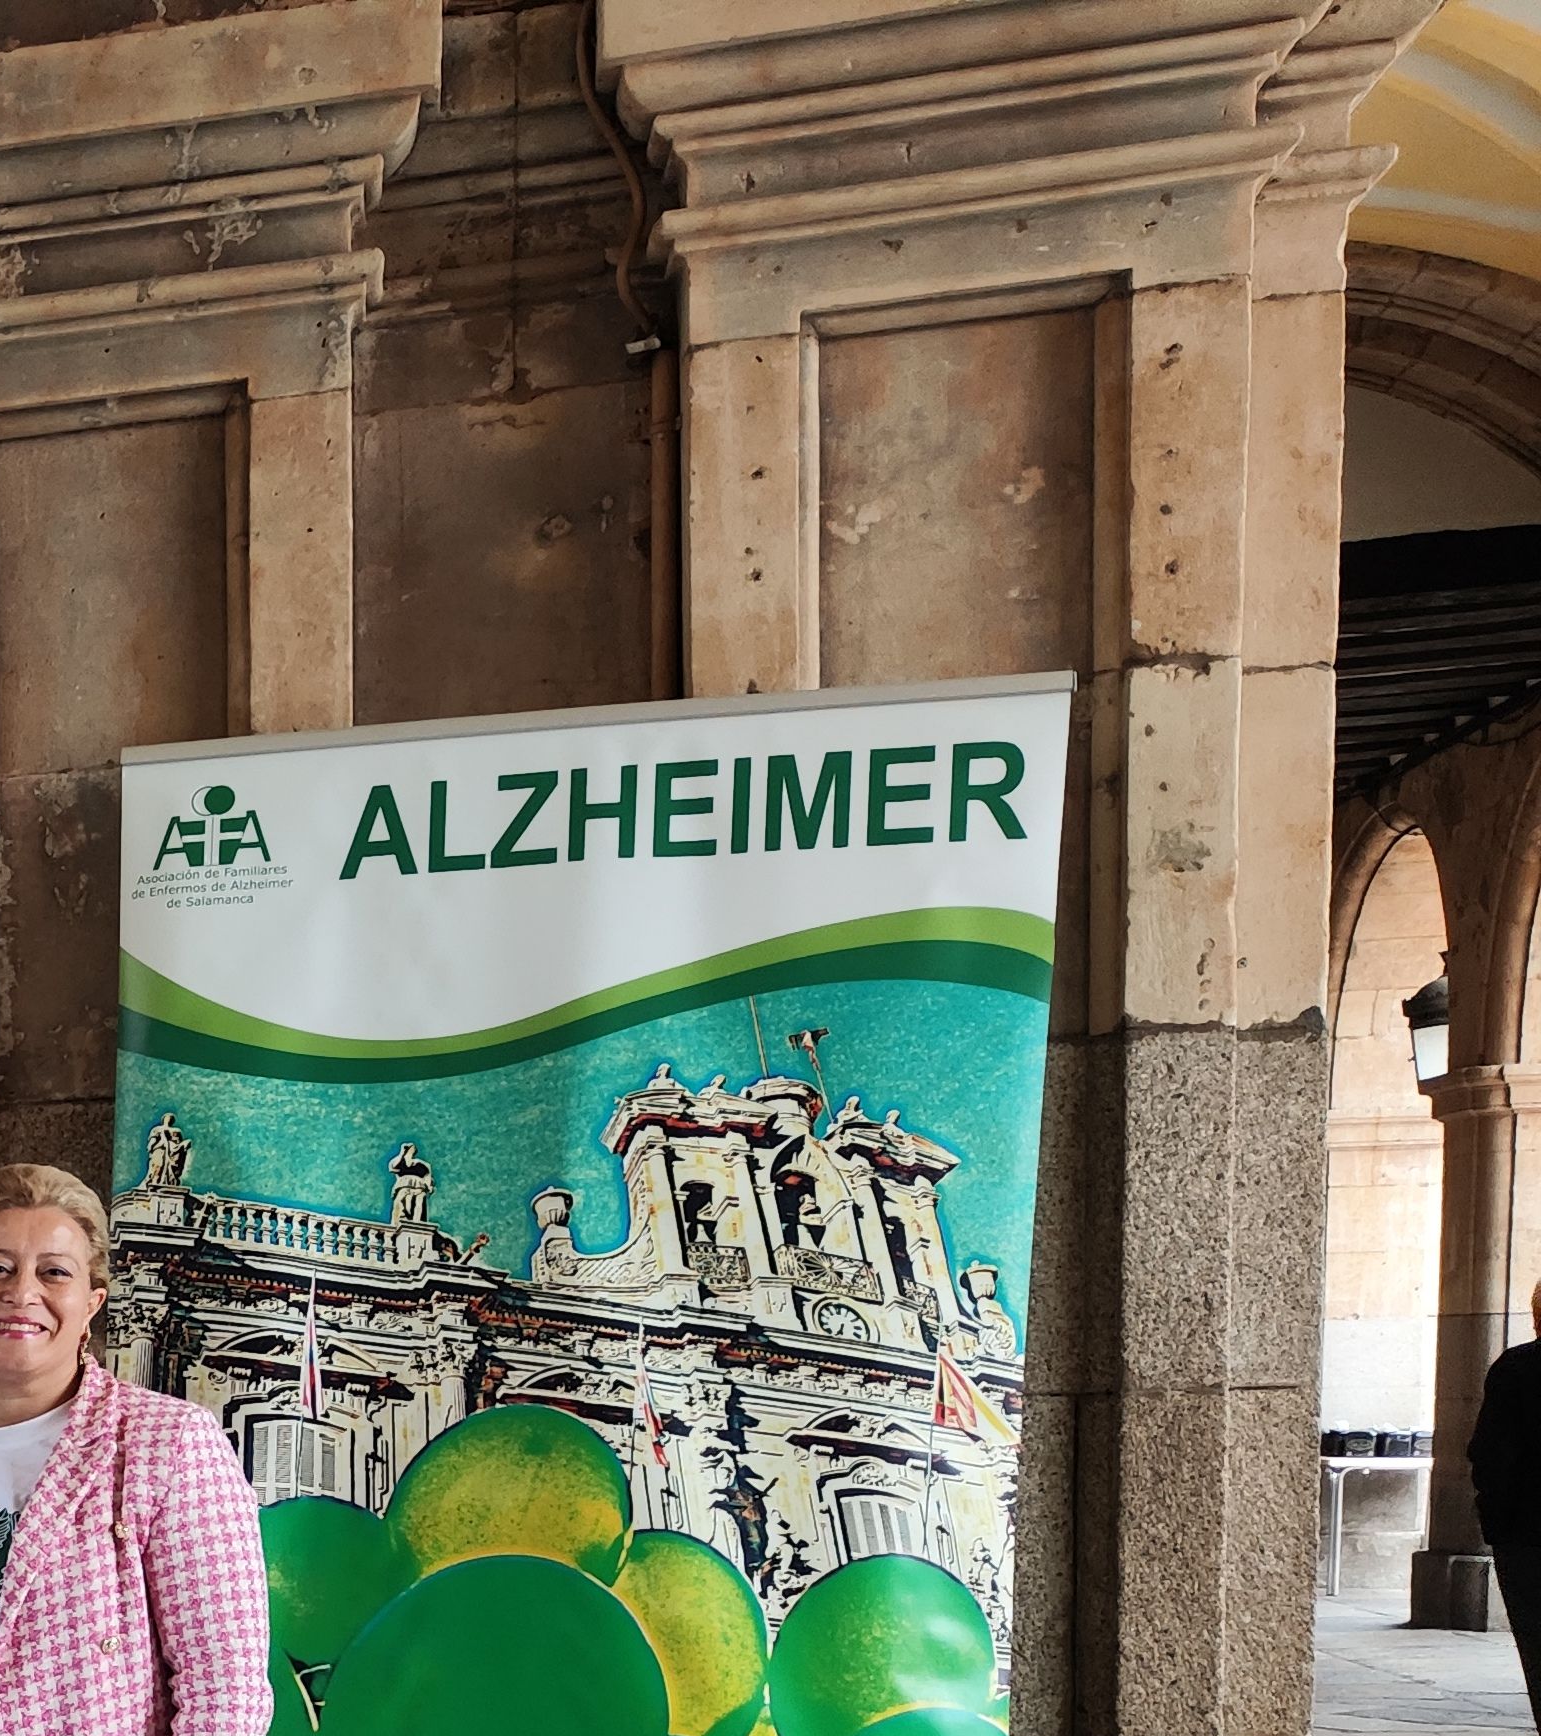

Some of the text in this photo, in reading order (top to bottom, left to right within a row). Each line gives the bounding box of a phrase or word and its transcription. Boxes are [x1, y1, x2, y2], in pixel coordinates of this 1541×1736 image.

[336, 740, 1029, 880] ALZHEIMER
[136, 865, 288, 886] Asociación de Familiares
[131, 878, 294, 900] de Enfermos de Alzheimer
[166, 894, 254, 909] de Salamanca
